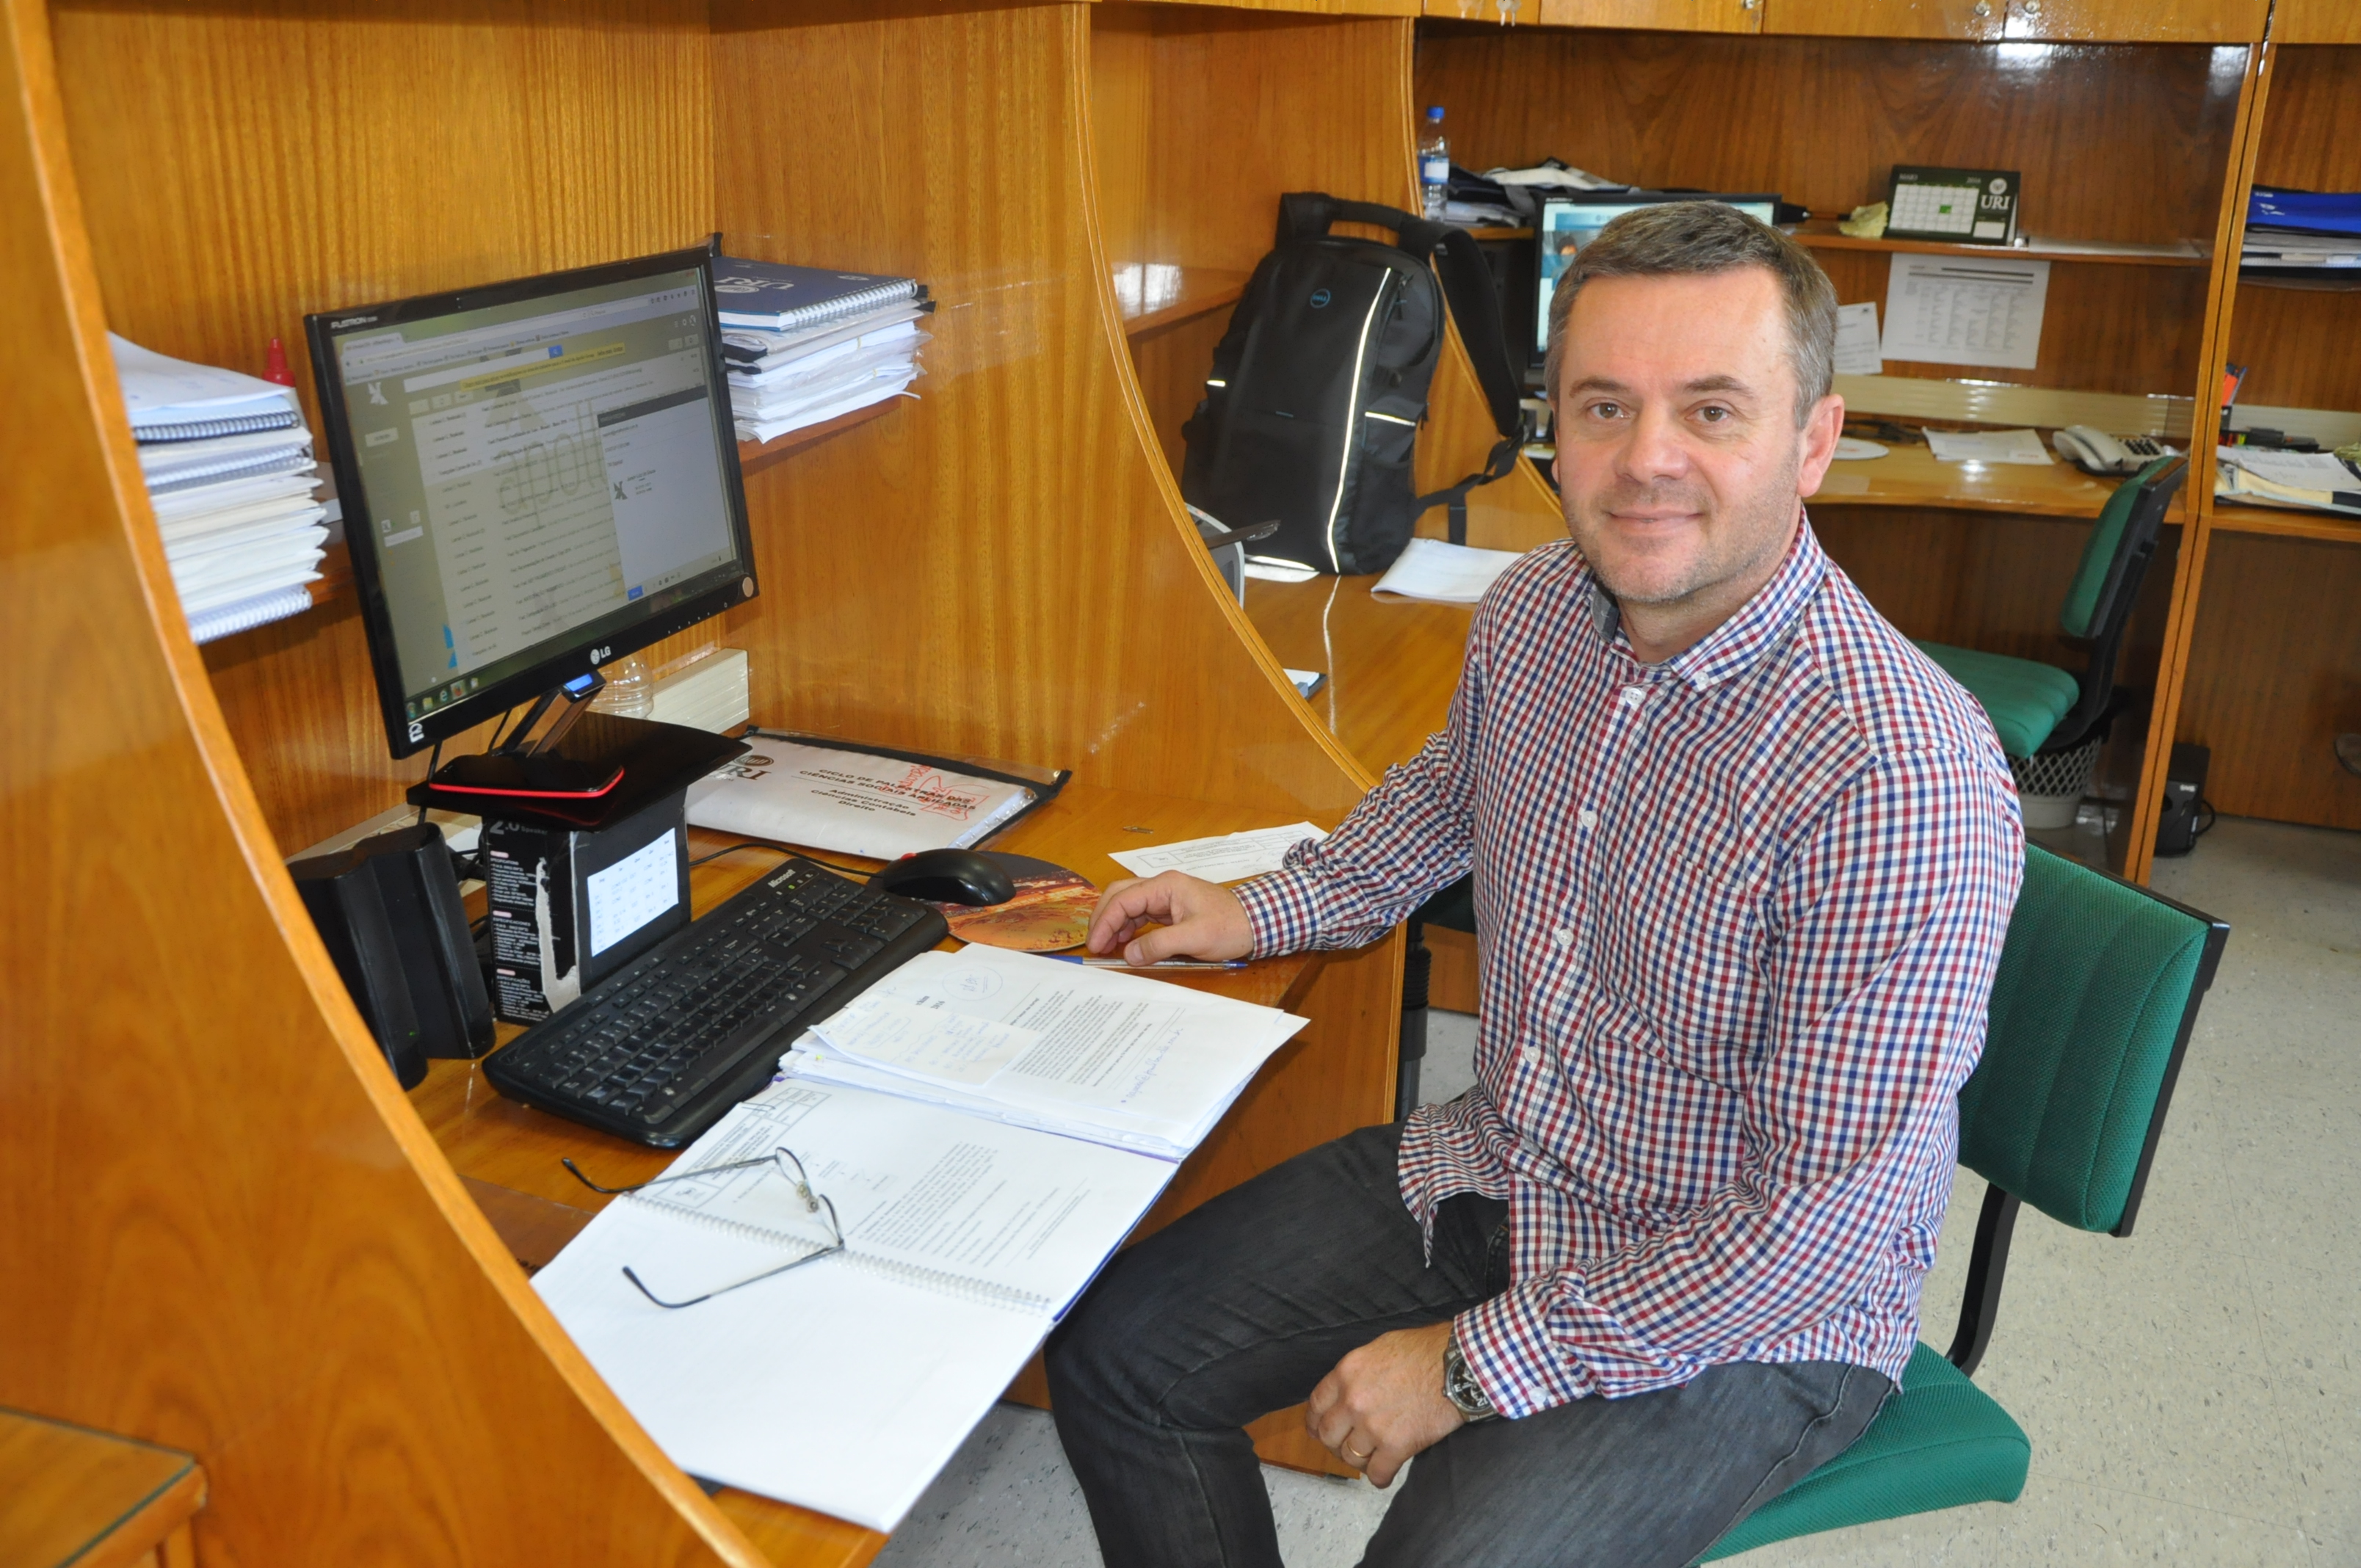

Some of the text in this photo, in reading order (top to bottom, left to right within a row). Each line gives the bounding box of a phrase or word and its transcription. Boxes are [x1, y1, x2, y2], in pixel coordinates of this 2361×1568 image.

[1980, 195, 2011, 210] URI
[600, 646, 612, 658] LG
[799, 770, 855, 784] CIÊNCIAS
[857, 782, 906, 795] SOCIAIS
[907, 794, 976, 810] APLICADAS
[819, 769, 855, 779] CICLO
[875, 780, 944, 798] PALESTRAS
[946, 795, 972, 804] DAS
[838, 800, 876, 811] Direito
[489, 819, 548, 835] 2.0 Speaker
[767, 868, 797, 888] Microsoft
